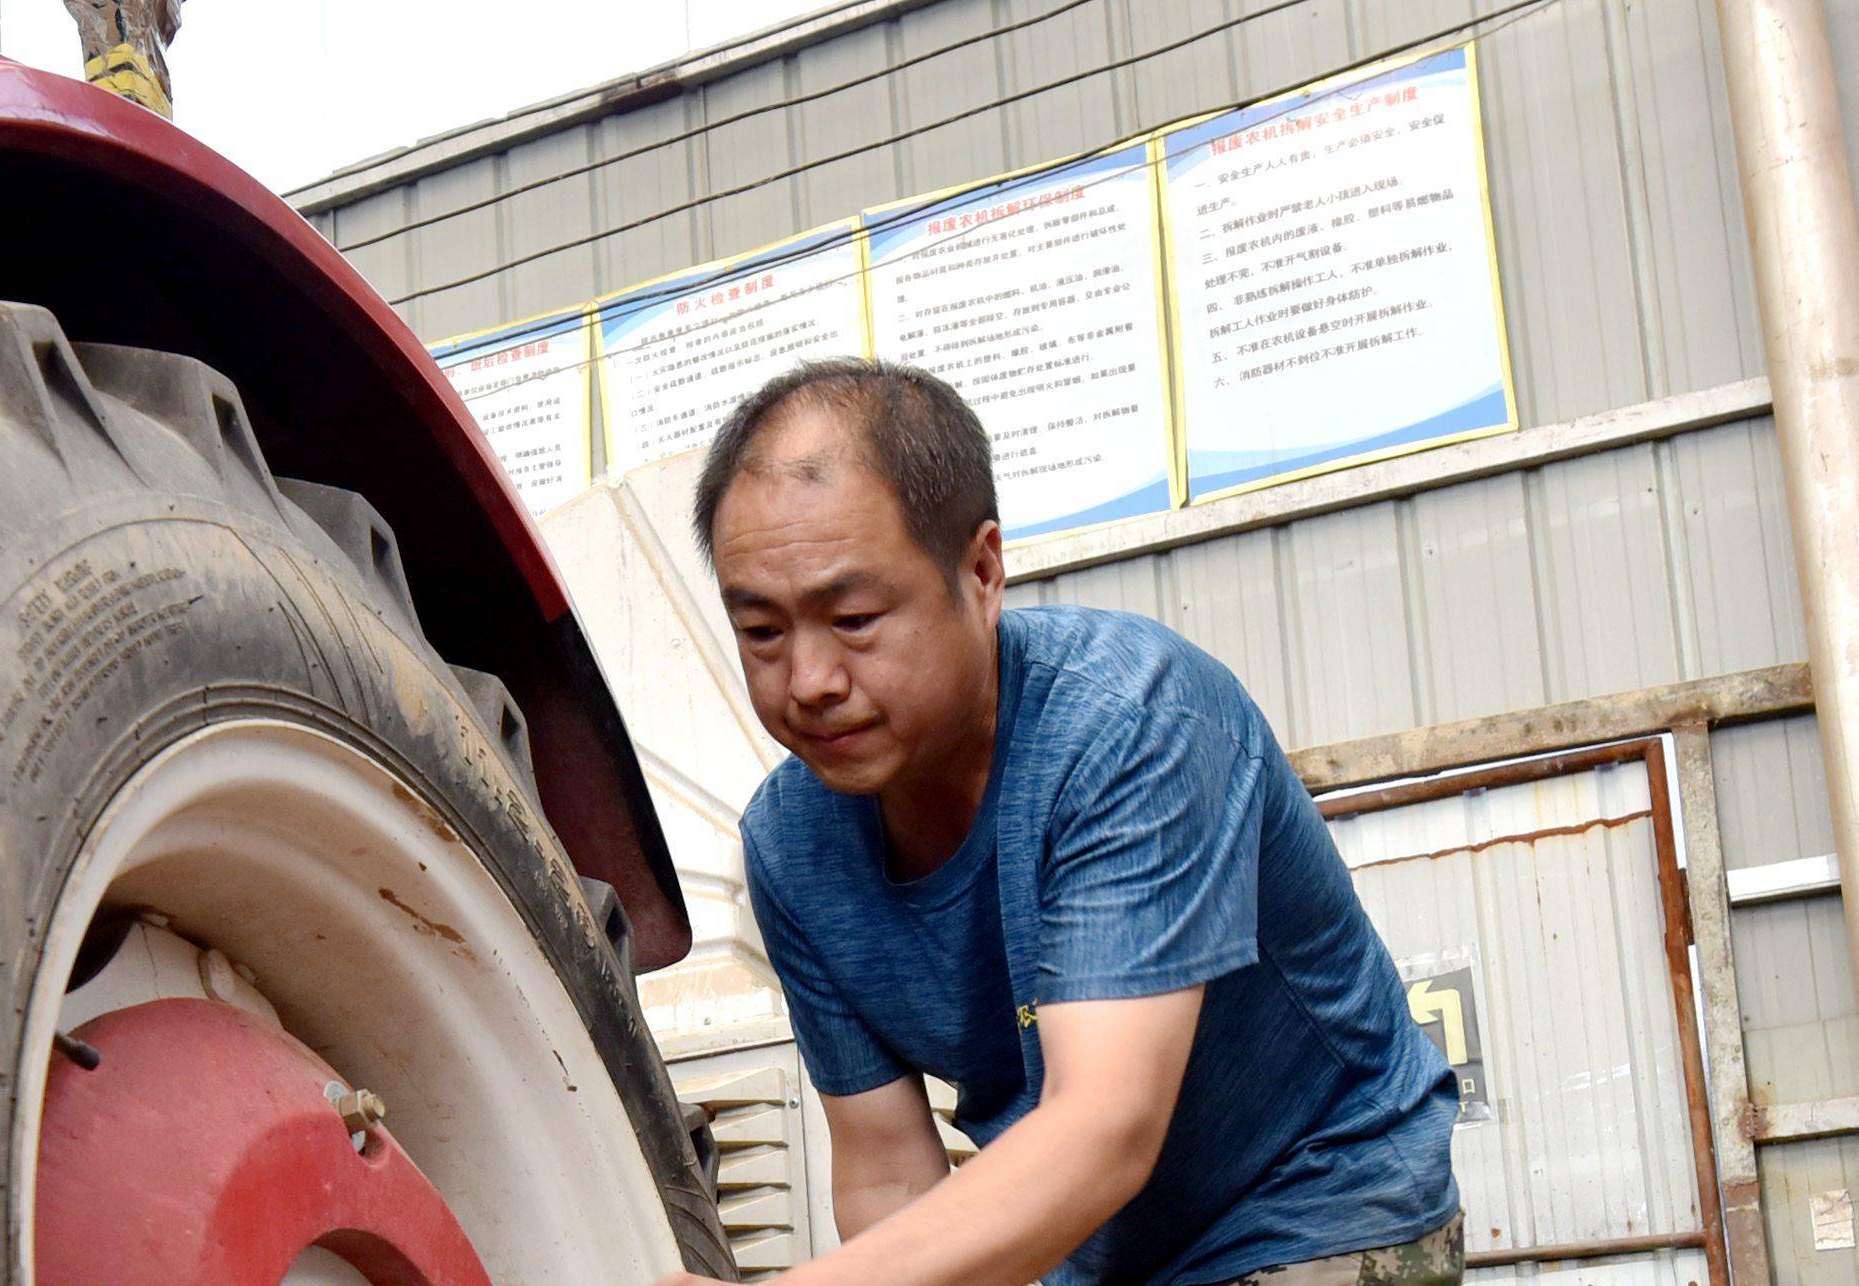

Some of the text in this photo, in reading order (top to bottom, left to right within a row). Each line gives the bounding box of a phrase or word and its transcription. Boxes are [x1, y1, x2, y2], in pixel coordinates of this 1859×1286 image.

[1210, 84, 1419, 158] 报废农机拆解安全生产制度
[676, 272, 774, 317] 防火检查制度
